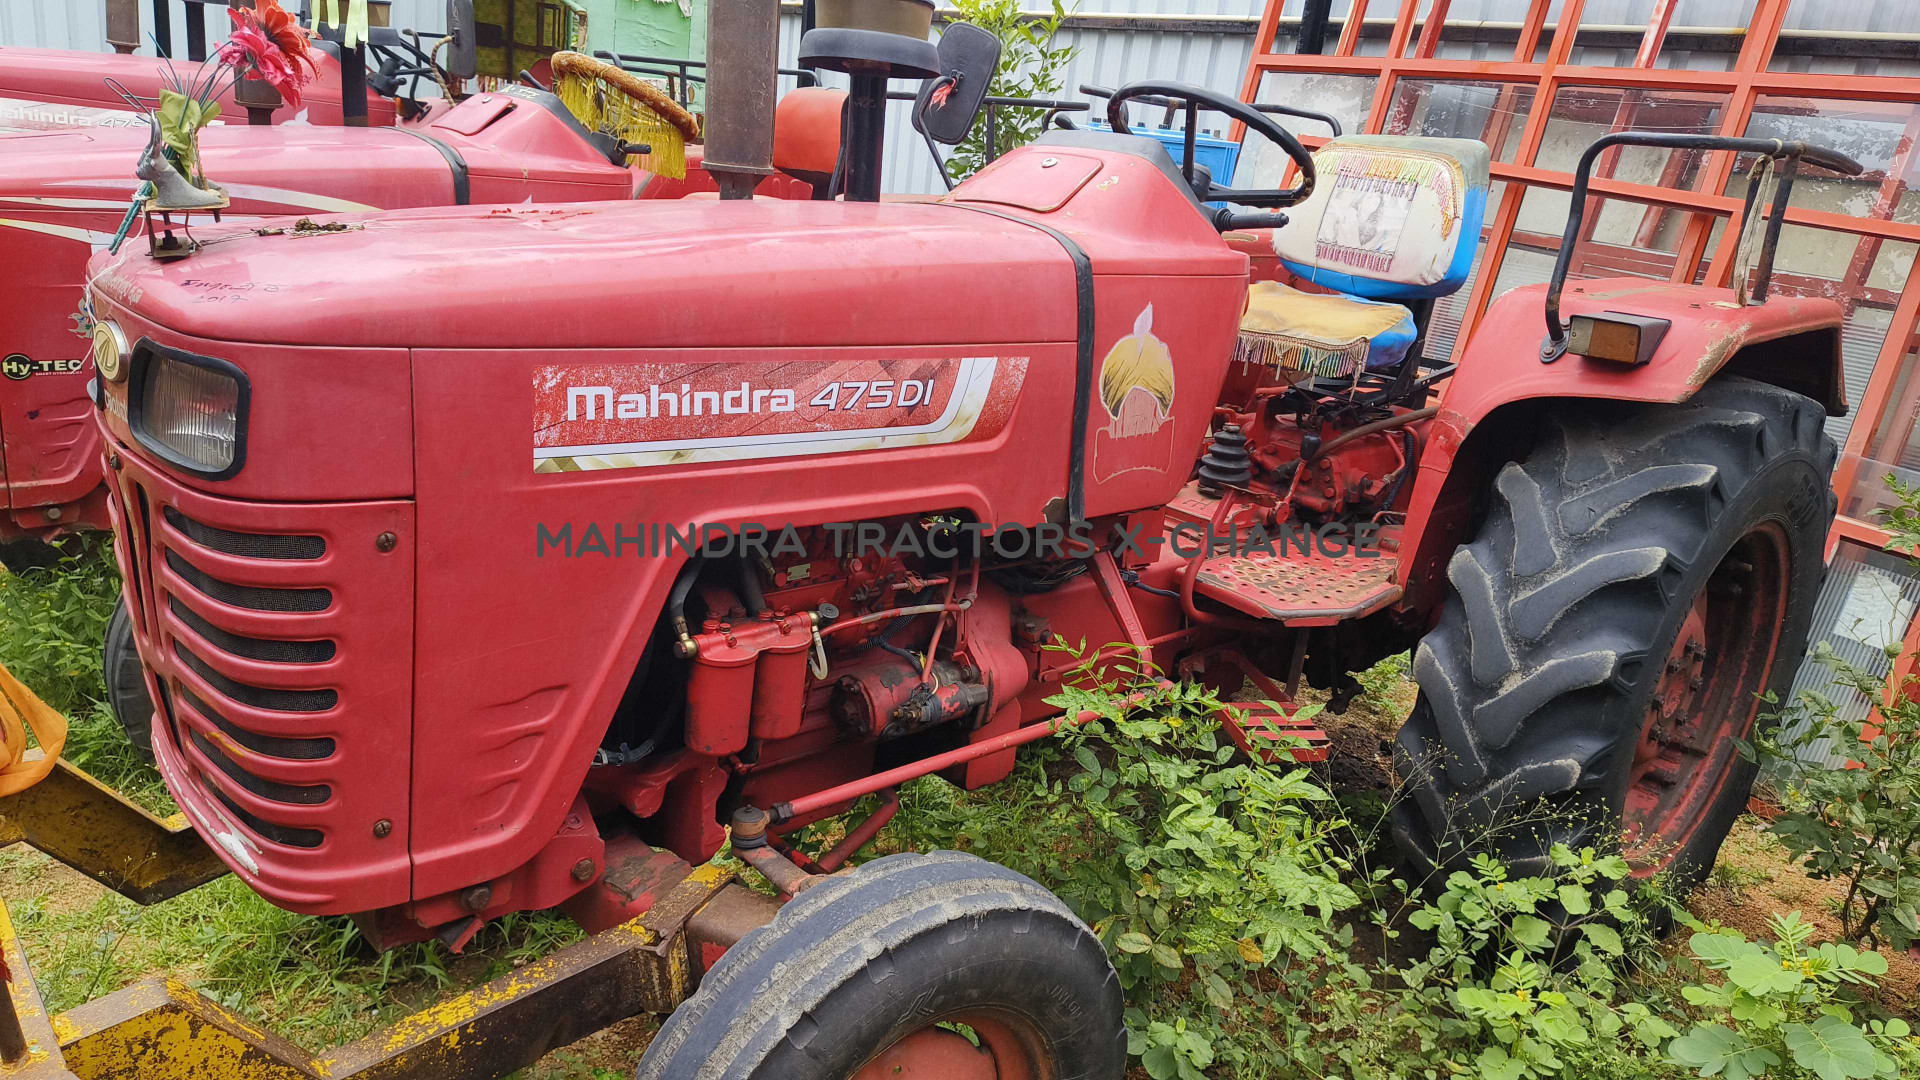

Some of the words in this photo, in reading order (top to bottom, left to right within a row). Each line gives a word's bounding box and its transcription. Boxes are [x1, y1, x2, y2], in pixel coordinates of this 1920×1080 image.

[0, 107, 92, 127] ahindra
[2, 359, 82, 376] Hy-TEC
[567, 382, 795, 421] Mahindra
